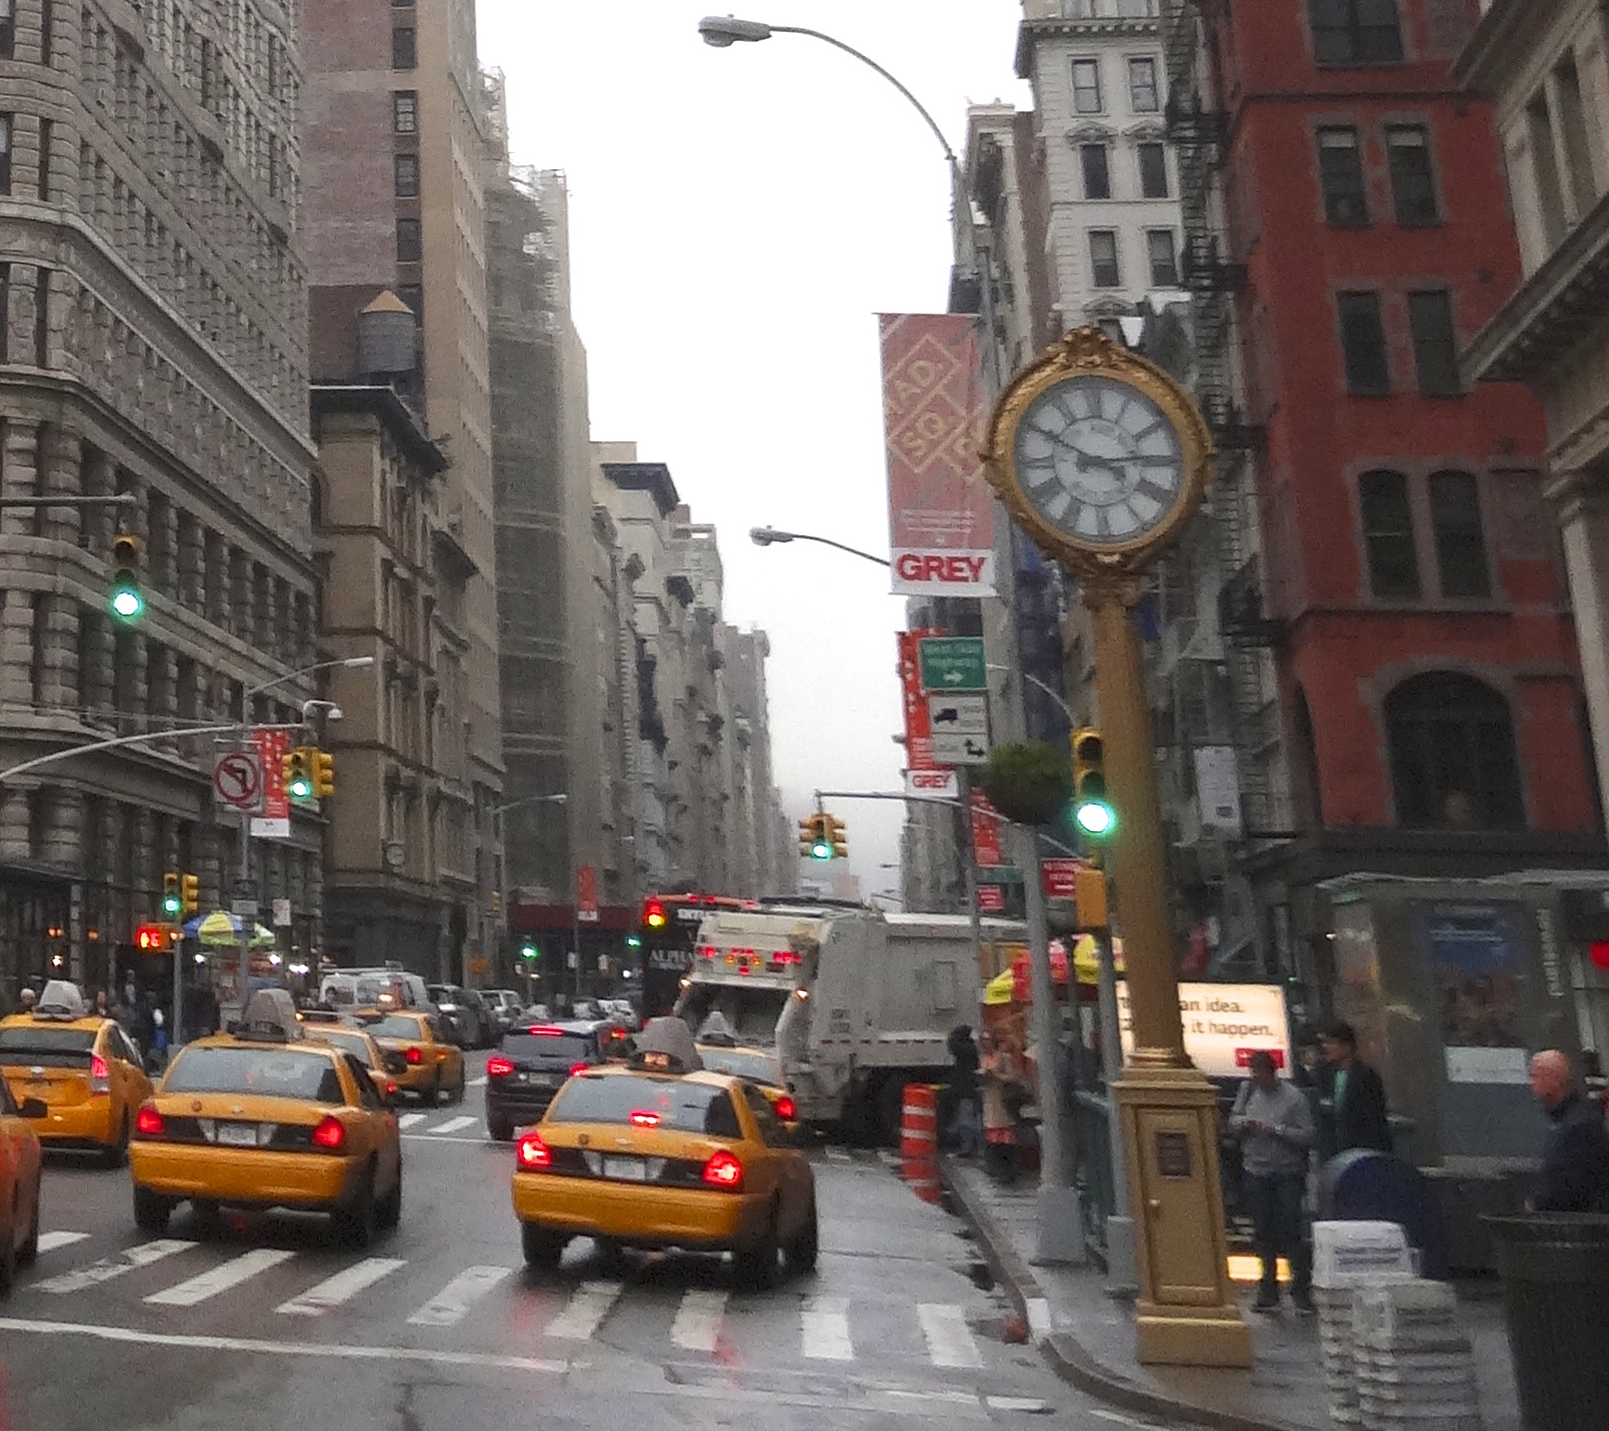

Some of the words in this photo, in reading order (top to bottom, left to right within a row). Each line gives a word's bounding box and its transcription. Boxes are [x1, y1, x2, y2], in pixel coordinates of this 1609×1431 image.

[896, 554, 986, 582] GREY
[912, 774, 951, 788] GREY
[1205, 996, 1246, 1013] idea.
[1209, 1019, 1275, 1040] happen.
